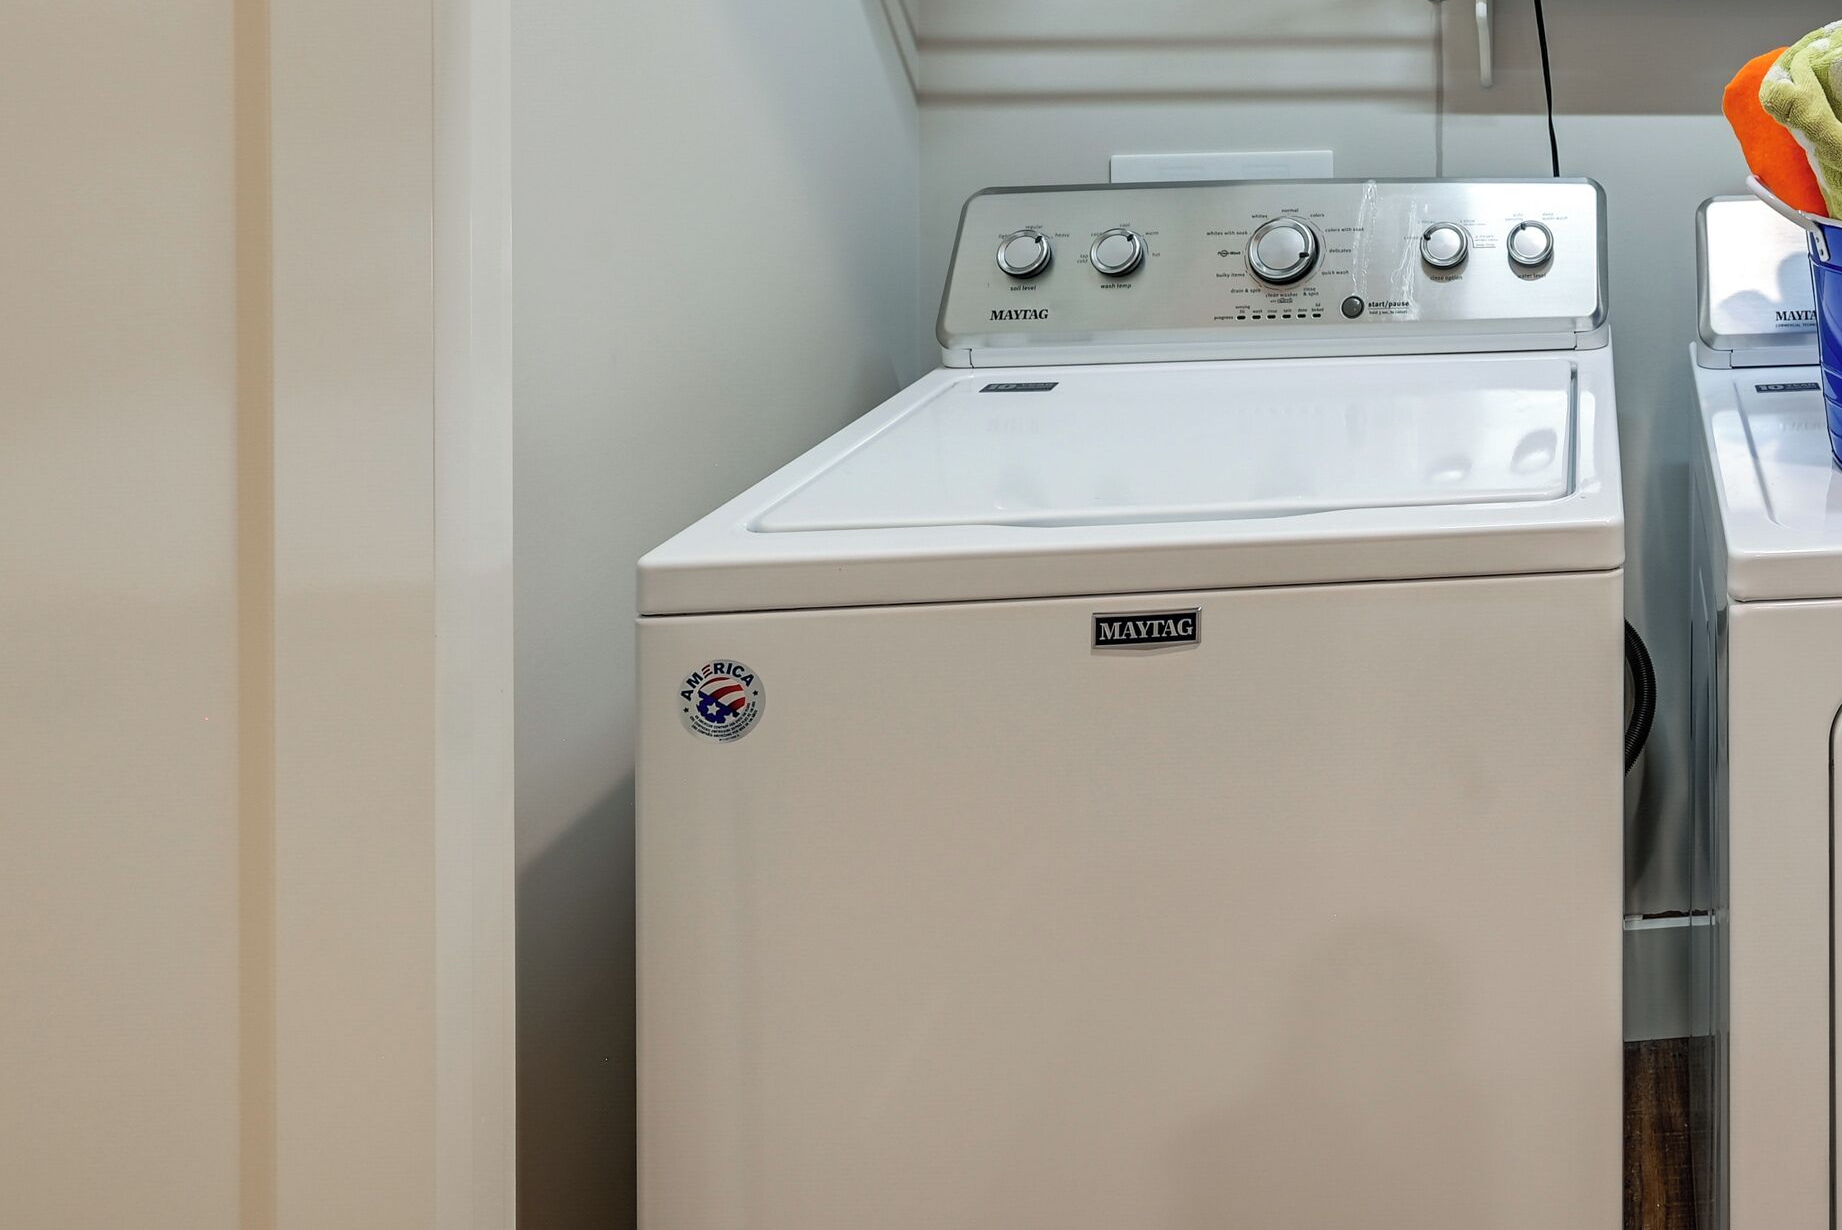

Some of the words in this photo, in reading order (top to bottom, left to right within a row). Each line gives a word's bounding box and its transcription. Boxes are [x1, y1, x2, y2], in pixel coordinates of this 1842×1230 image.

[990, 309, 1049, 320] MAYTAG
[1775, 310, 1816, 321] MAYTA
[1099, 618, 1194, 640] MAYTAG
[680, 662, 754, 701] AMERICA
